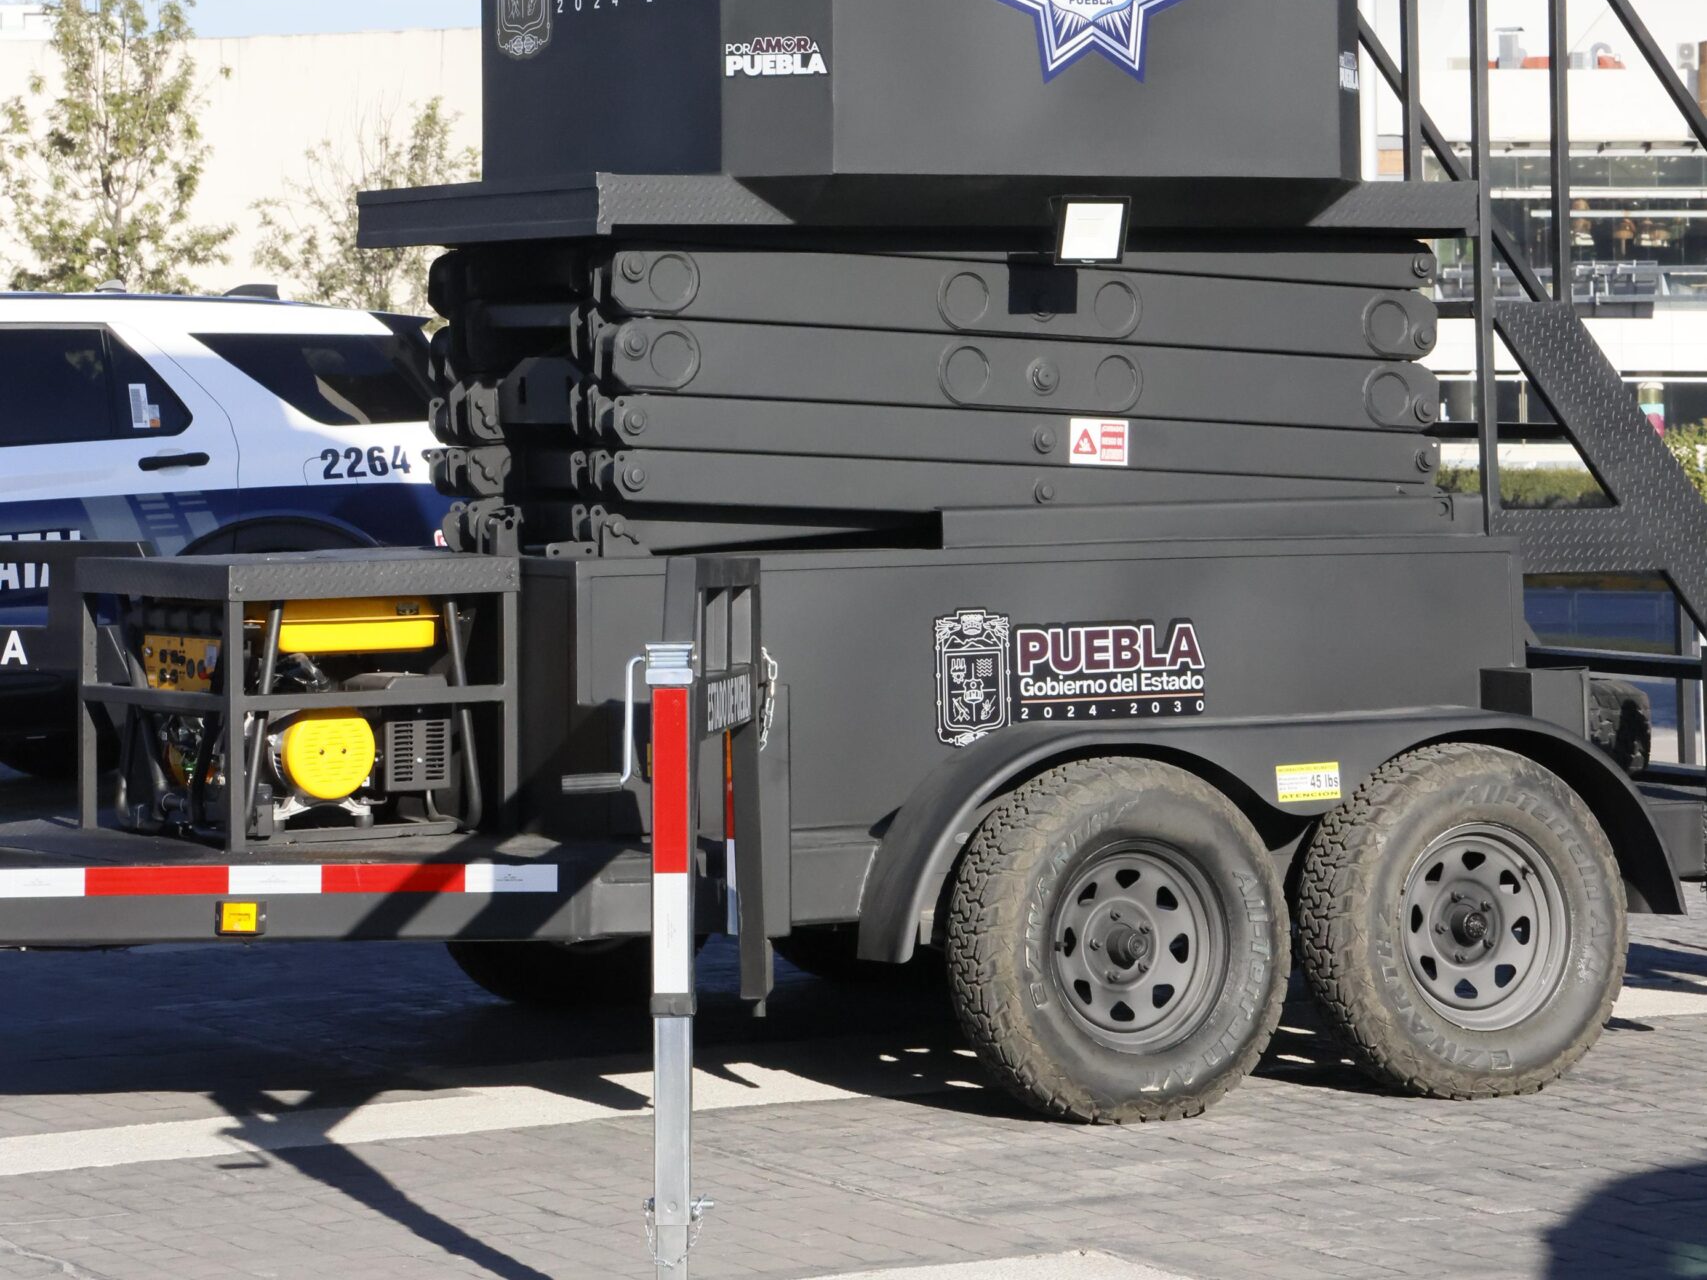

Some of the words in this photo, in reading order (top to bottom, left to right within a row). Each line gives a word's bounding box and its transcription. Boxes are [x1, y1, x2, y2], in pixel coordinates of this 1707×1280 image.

[725, 43, 751, 54] POR
[749, 36, 811, 55] AMOR
[809, 43, 819, 53] A
[725, 53, 828, 76] PUEBLA
[320, 445, 411, 479] 2264
[1017, 623, 1205, 675] PUEBLA
[1020, 674, 1107, 697] Gobierno
[1109, 673, 1138, 693] del
[1141, 671, 1204, 691] Estado
[1020, 699, 1205, 719] 2024-2030
[1310, 774, 1322, 788] 45
[1324, 773, 1339, 788] lbs
